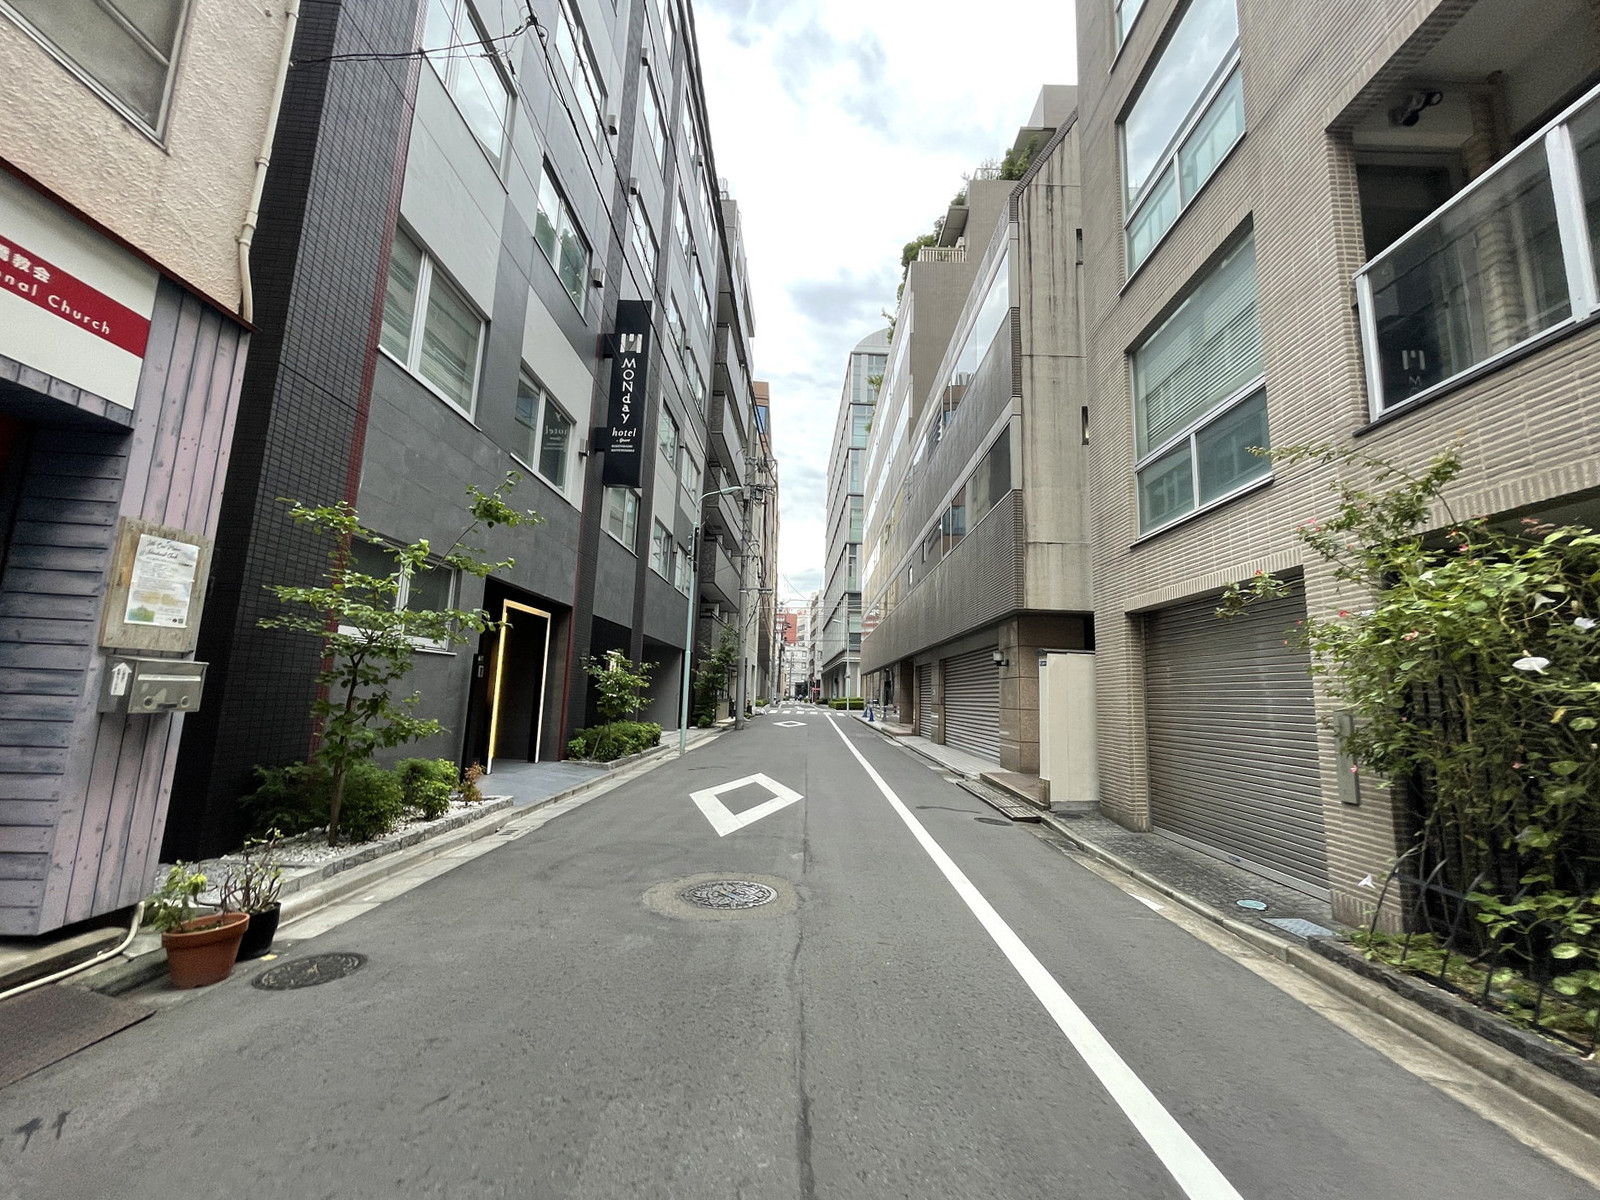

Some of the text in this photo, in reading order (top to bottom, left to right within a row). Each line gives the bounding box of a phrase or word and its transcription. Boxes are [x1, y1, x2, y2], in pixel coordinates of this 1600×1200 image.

[0, 270, 111, 335] nal Church
[611, 427, 636, 437] hotel
